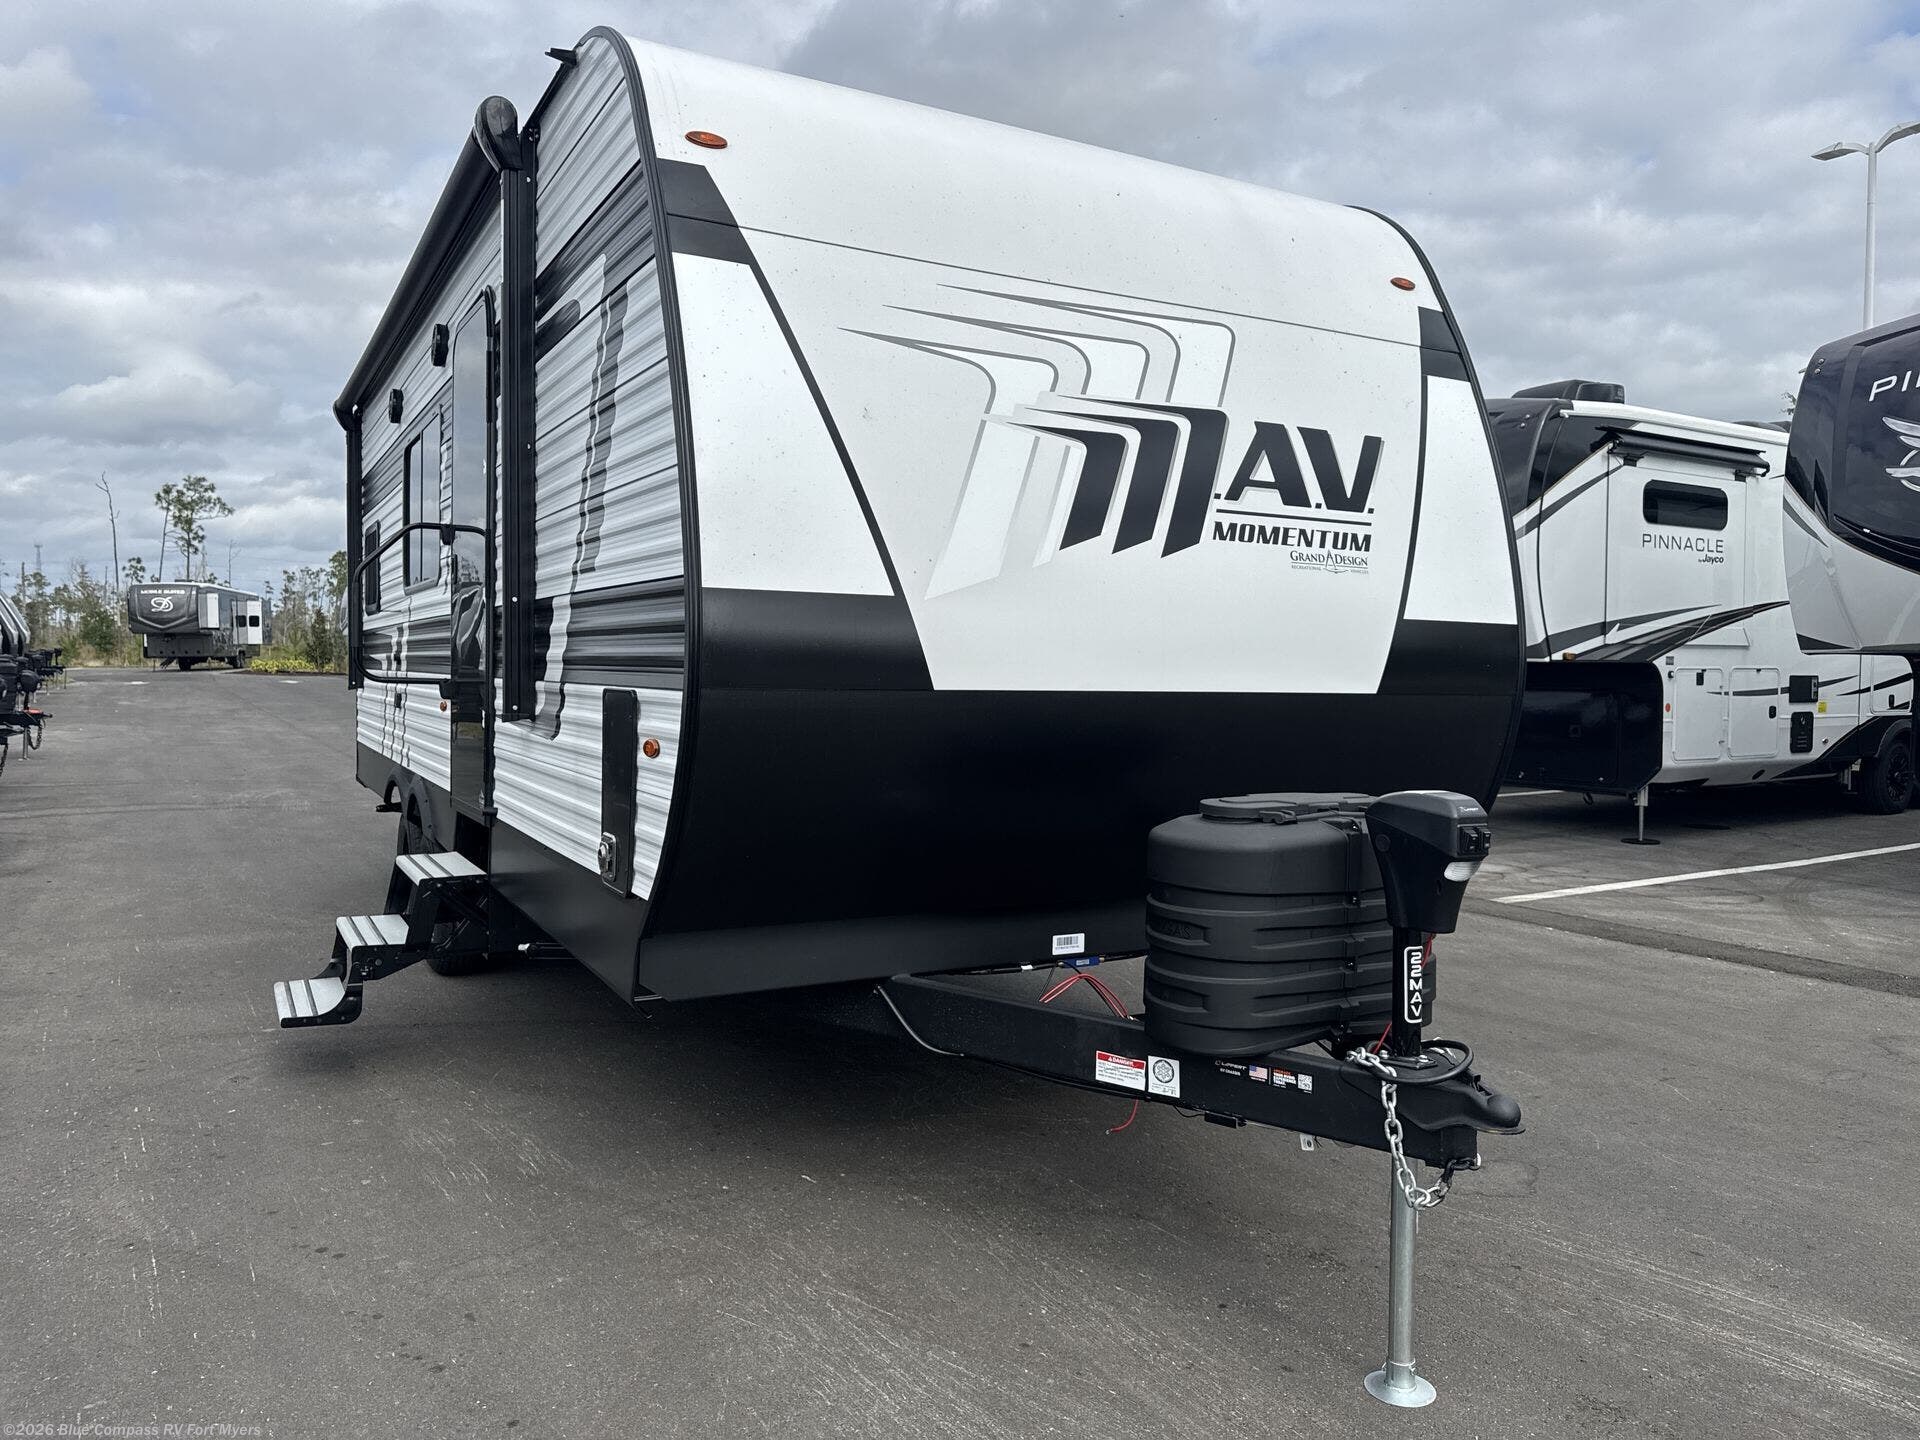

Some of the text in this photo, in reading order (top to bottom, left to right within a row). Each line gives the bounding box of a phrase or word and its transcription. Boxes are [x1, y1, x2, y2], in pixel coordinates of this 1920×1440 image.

[1868, 369, 1920, 402] PI
[1212, 521, 1372, 552] MOMENTUM
[1642, 533, 1724, 554] PINNACLE
[1290, 550, 1368, 566] GRAND DESIGN
[1702, 554, 1724, 565] Jayco
[1409, 951, 1423, 1017] 22MAV
